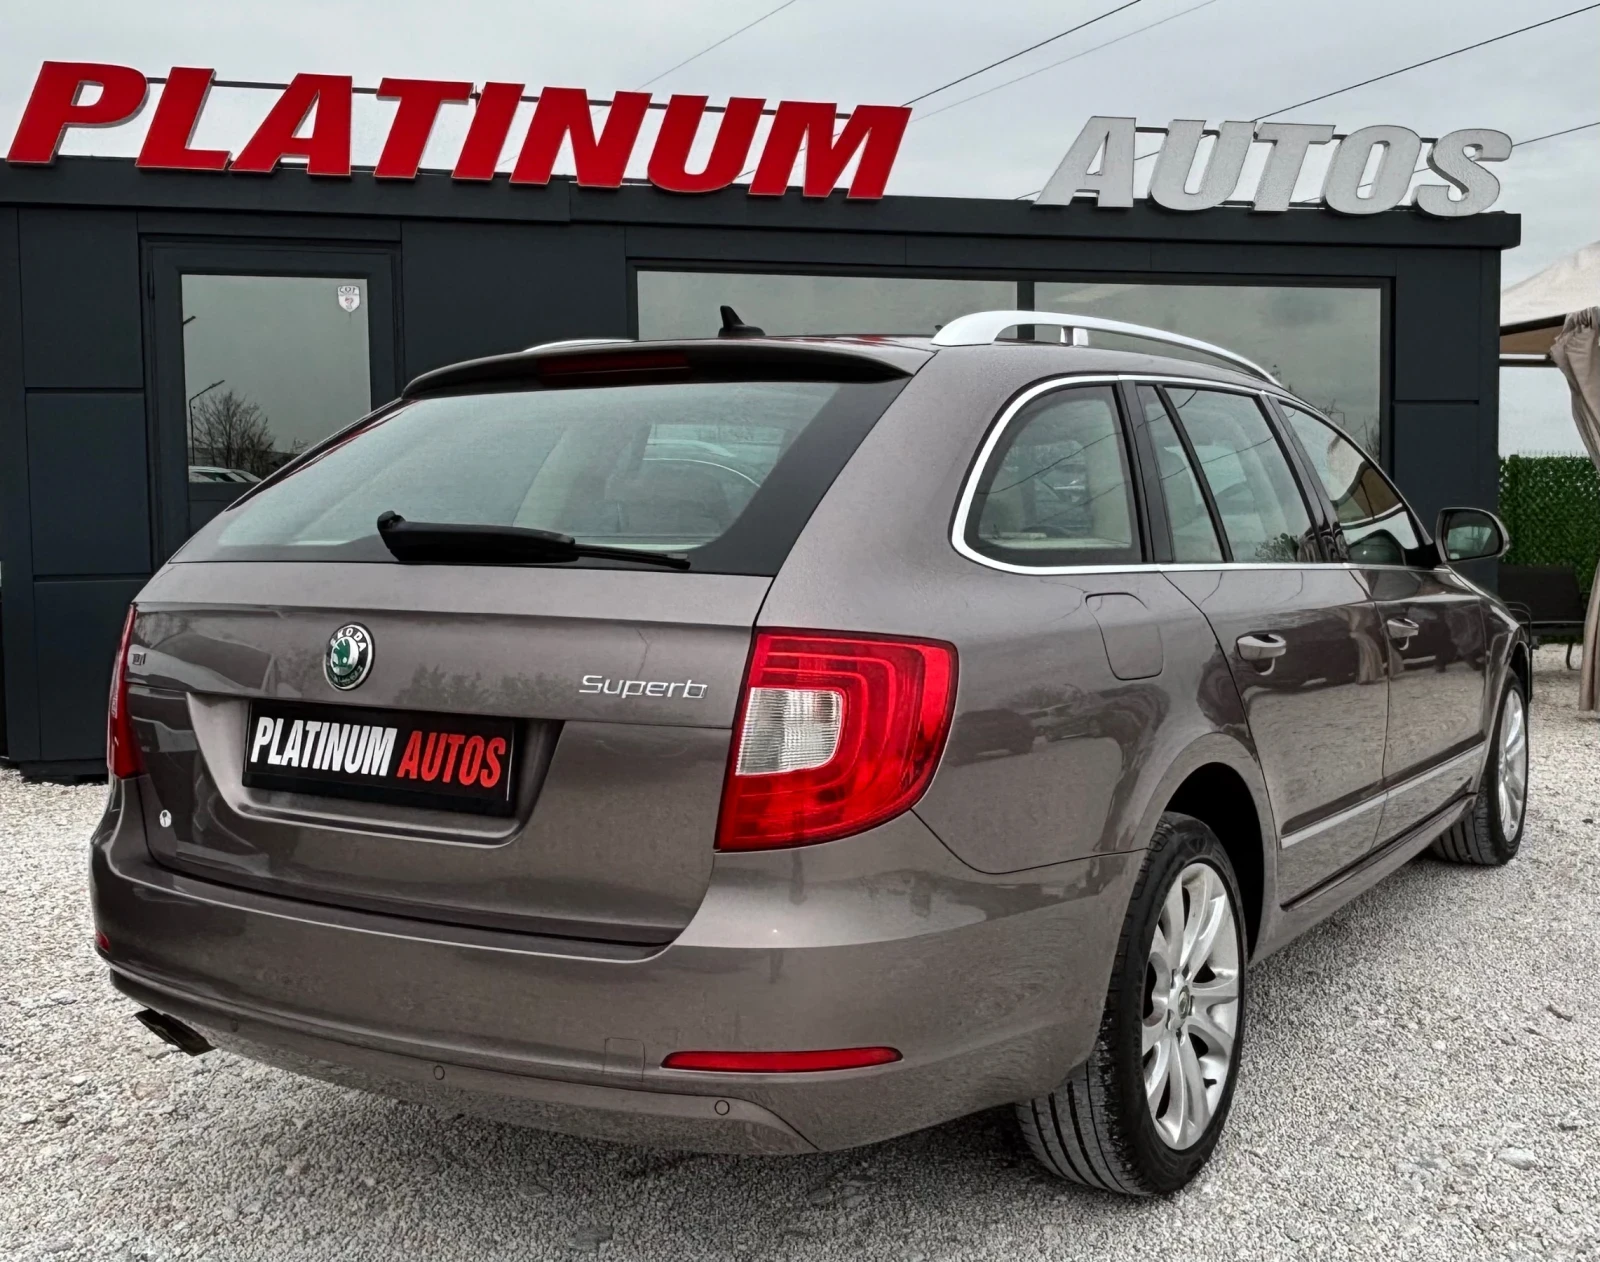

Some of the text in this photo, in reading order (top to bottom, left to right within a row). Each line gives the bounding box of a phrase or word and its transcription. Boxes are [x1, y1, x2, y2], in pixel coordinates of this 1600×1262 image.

[8, 61, 1513, 217] PLATINUM AUTOS
[578, 674, 708, 699] Superb
[250, 716, 506, 789] PLATINUM AUTOS
